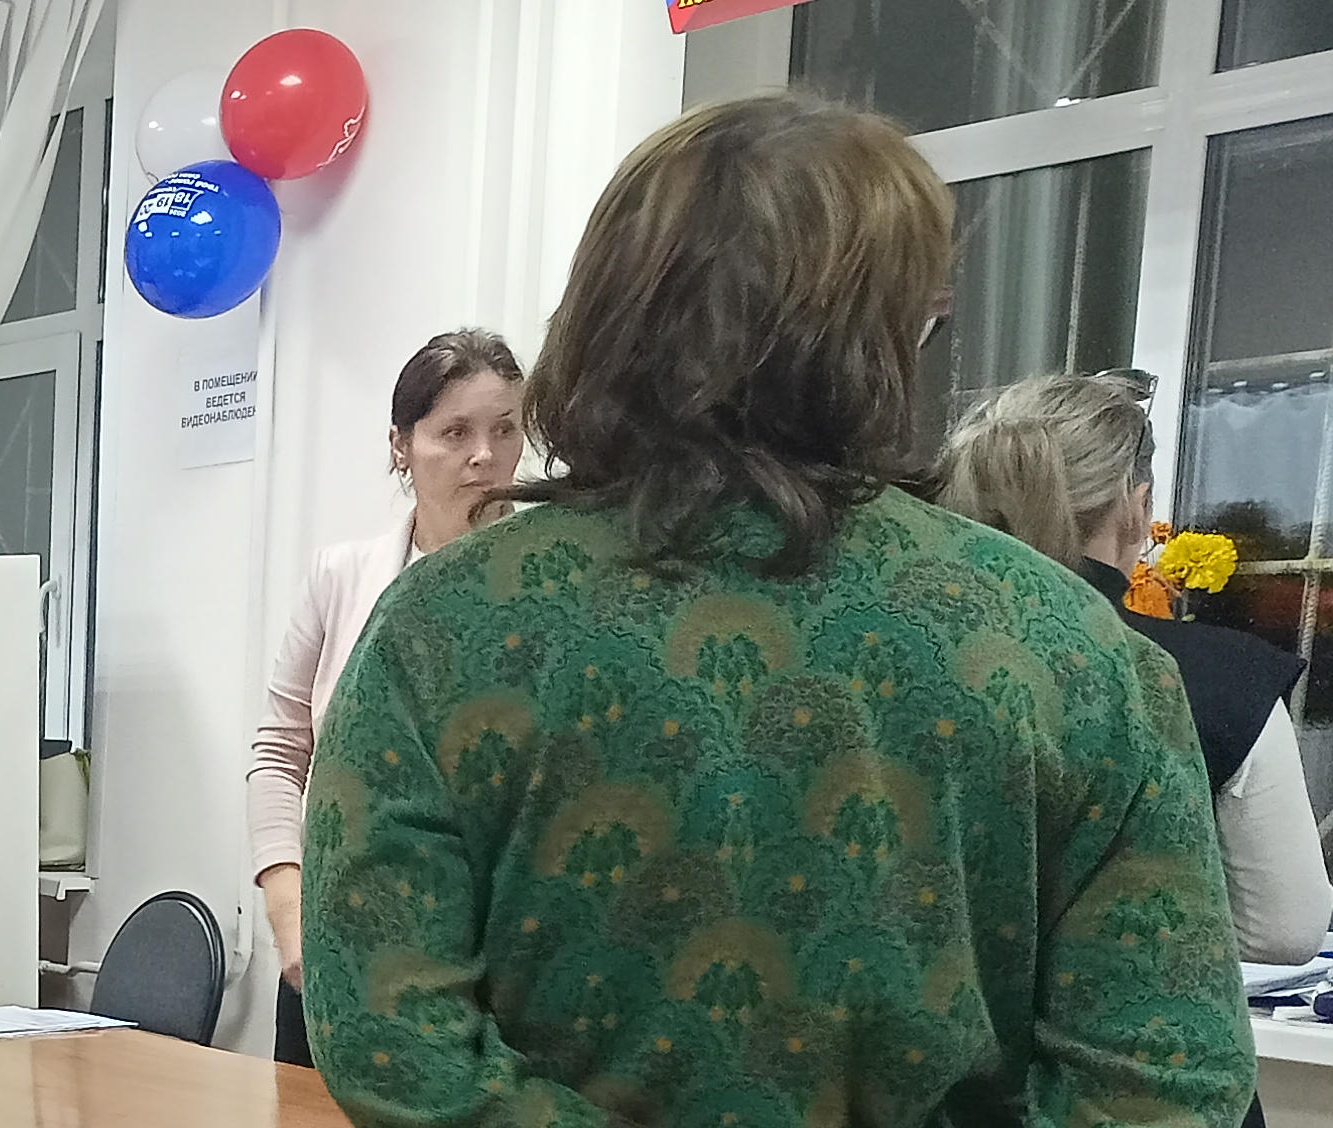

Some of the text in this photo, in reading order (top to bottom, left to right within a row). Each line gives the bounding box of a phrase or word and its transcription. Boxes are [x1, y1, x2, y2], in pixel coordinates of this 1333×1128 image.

[156, 196, 170, 207] 19
[174, 192, 191, 204] 18
[194, 380, 201, 391] В
[205, 391, 246, 408] ВЕДЕТСЯ
